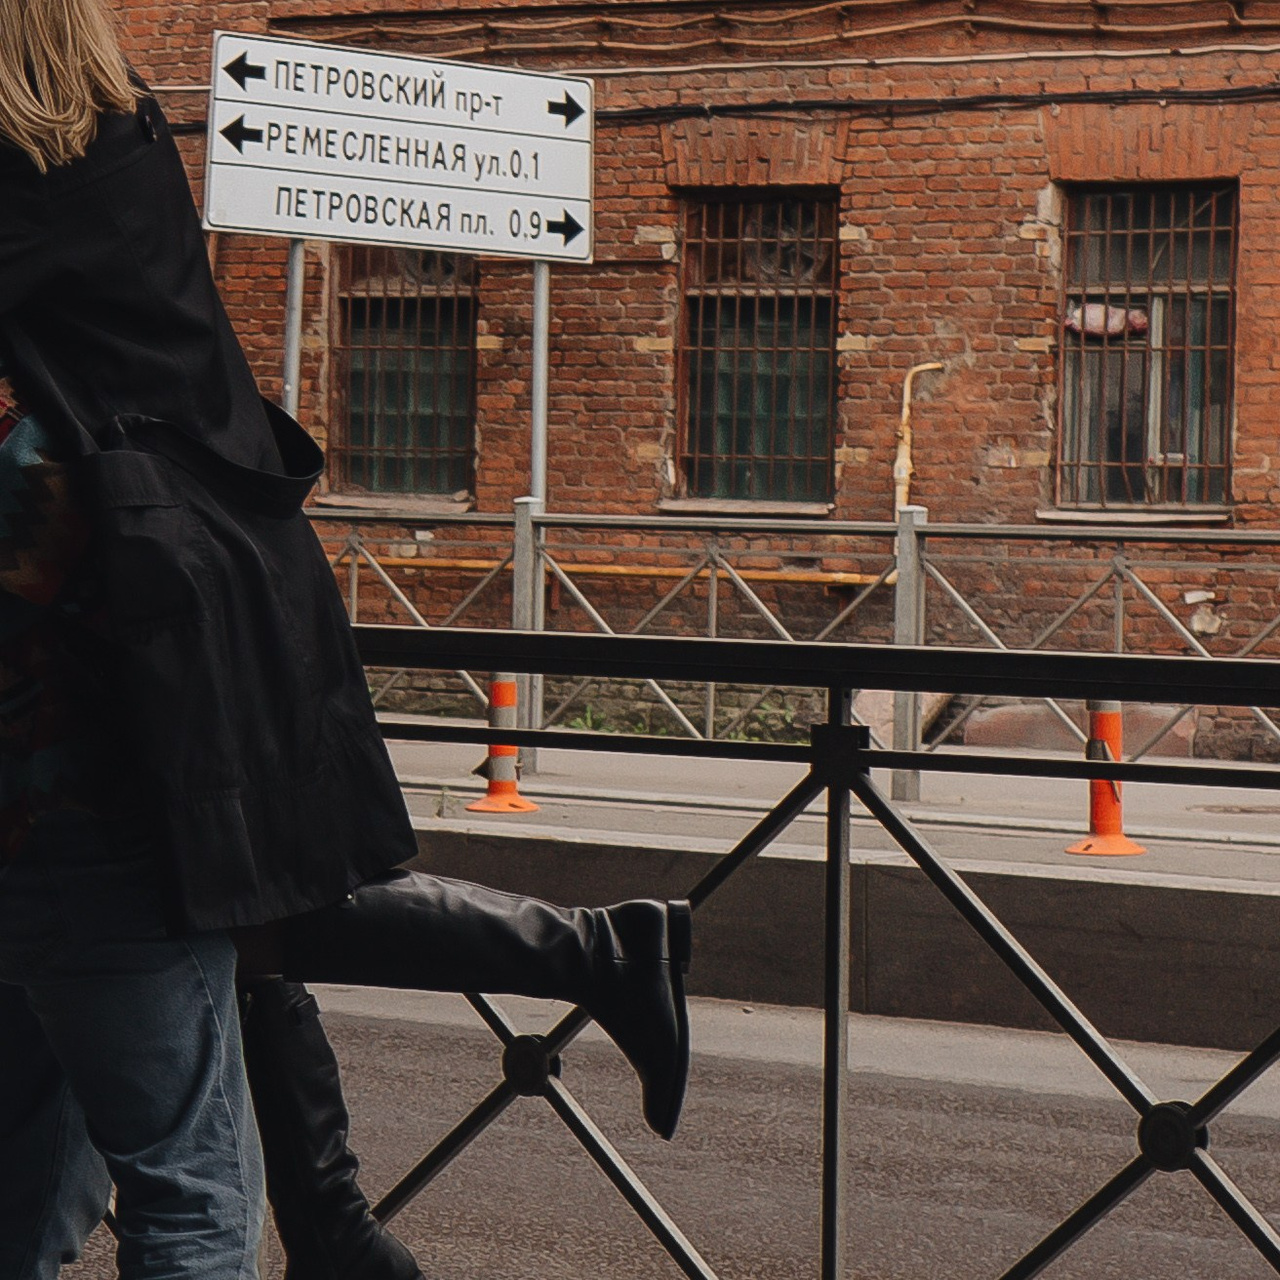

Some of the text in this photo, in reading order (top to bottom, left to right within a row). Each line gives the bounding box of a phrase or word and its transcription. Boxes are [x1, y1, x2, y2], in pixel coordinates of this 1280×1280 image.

[274, 59, 504, 122] ПЕТРОВСКИЙ пр-т
[266, 122, 467, 174] РЕМЕСЛЕННАЯ
[275, 186, 452, 233] ПЕТРОВСКАЯ
[460, 212, 495, 237] пл.
